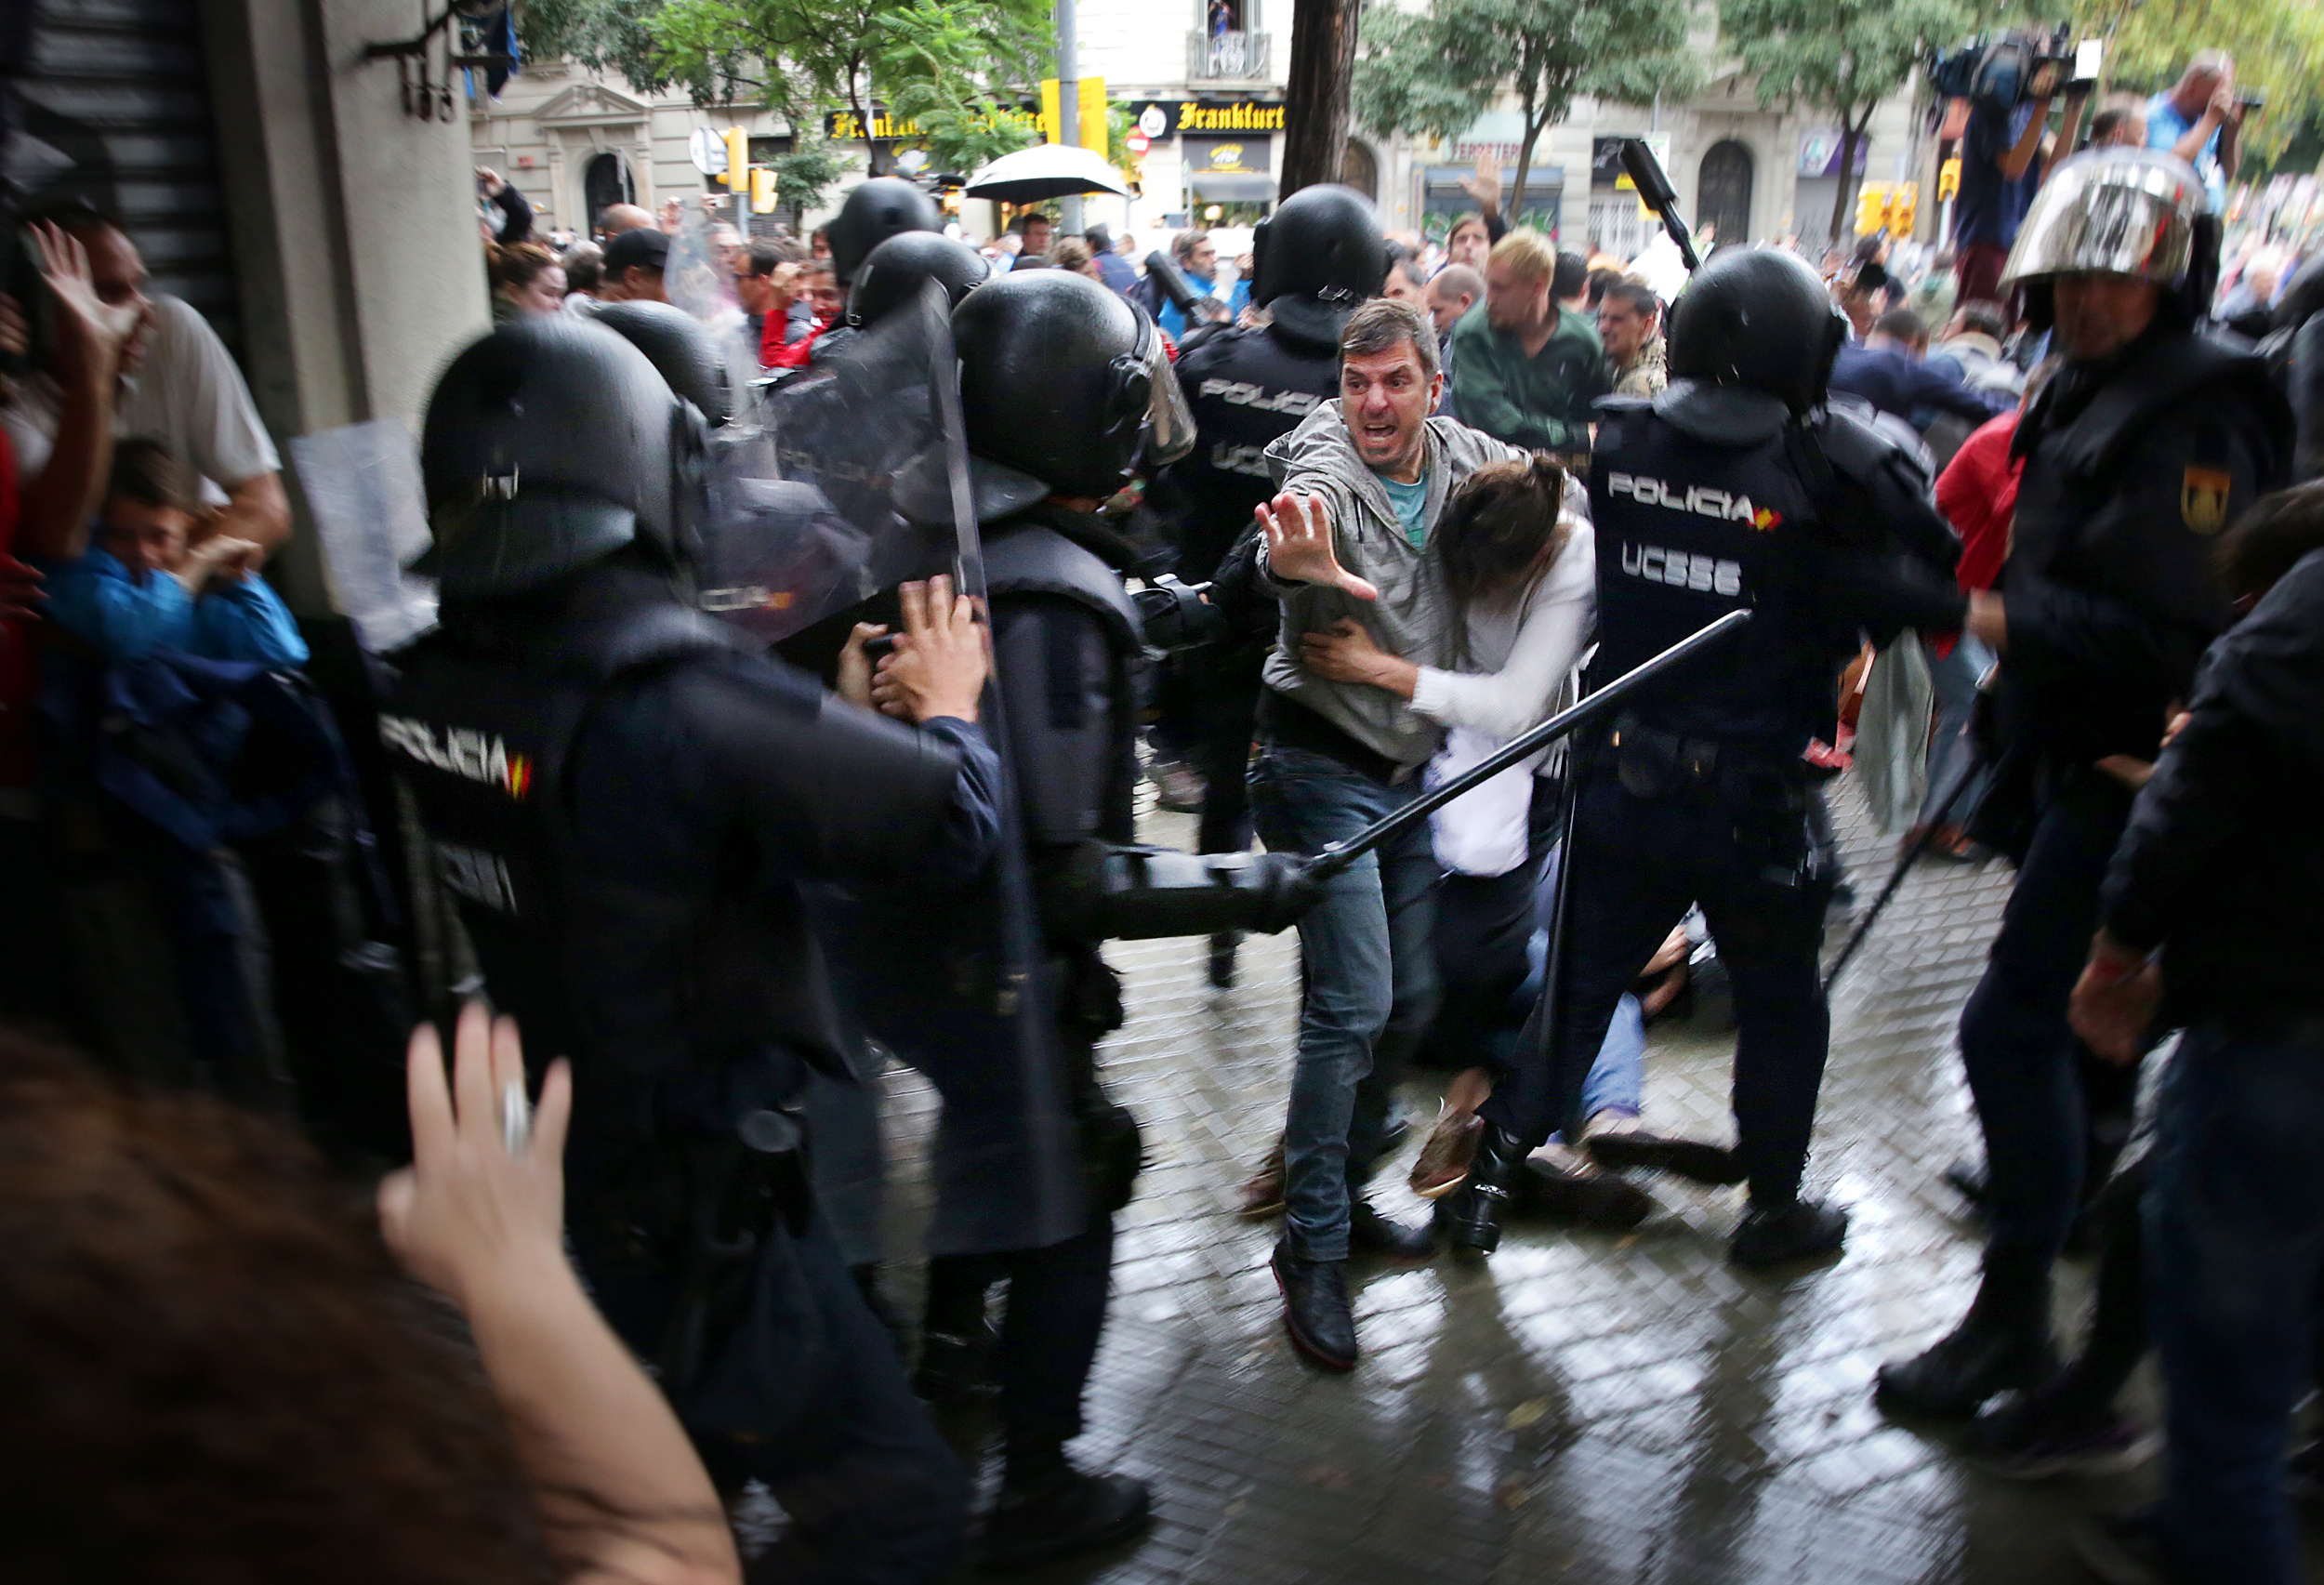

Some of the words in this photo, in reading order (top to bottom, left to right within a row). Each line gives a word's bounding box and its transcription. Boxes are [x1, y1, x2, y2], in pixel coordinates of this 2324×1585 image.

[1176, 101, 1286, 129] Frankfurt
[1199, 377, 1322, 416] POLICI
[1608, 471, 1756, 526] POLICIA
[378, 712, 510, 791] POLICIA
